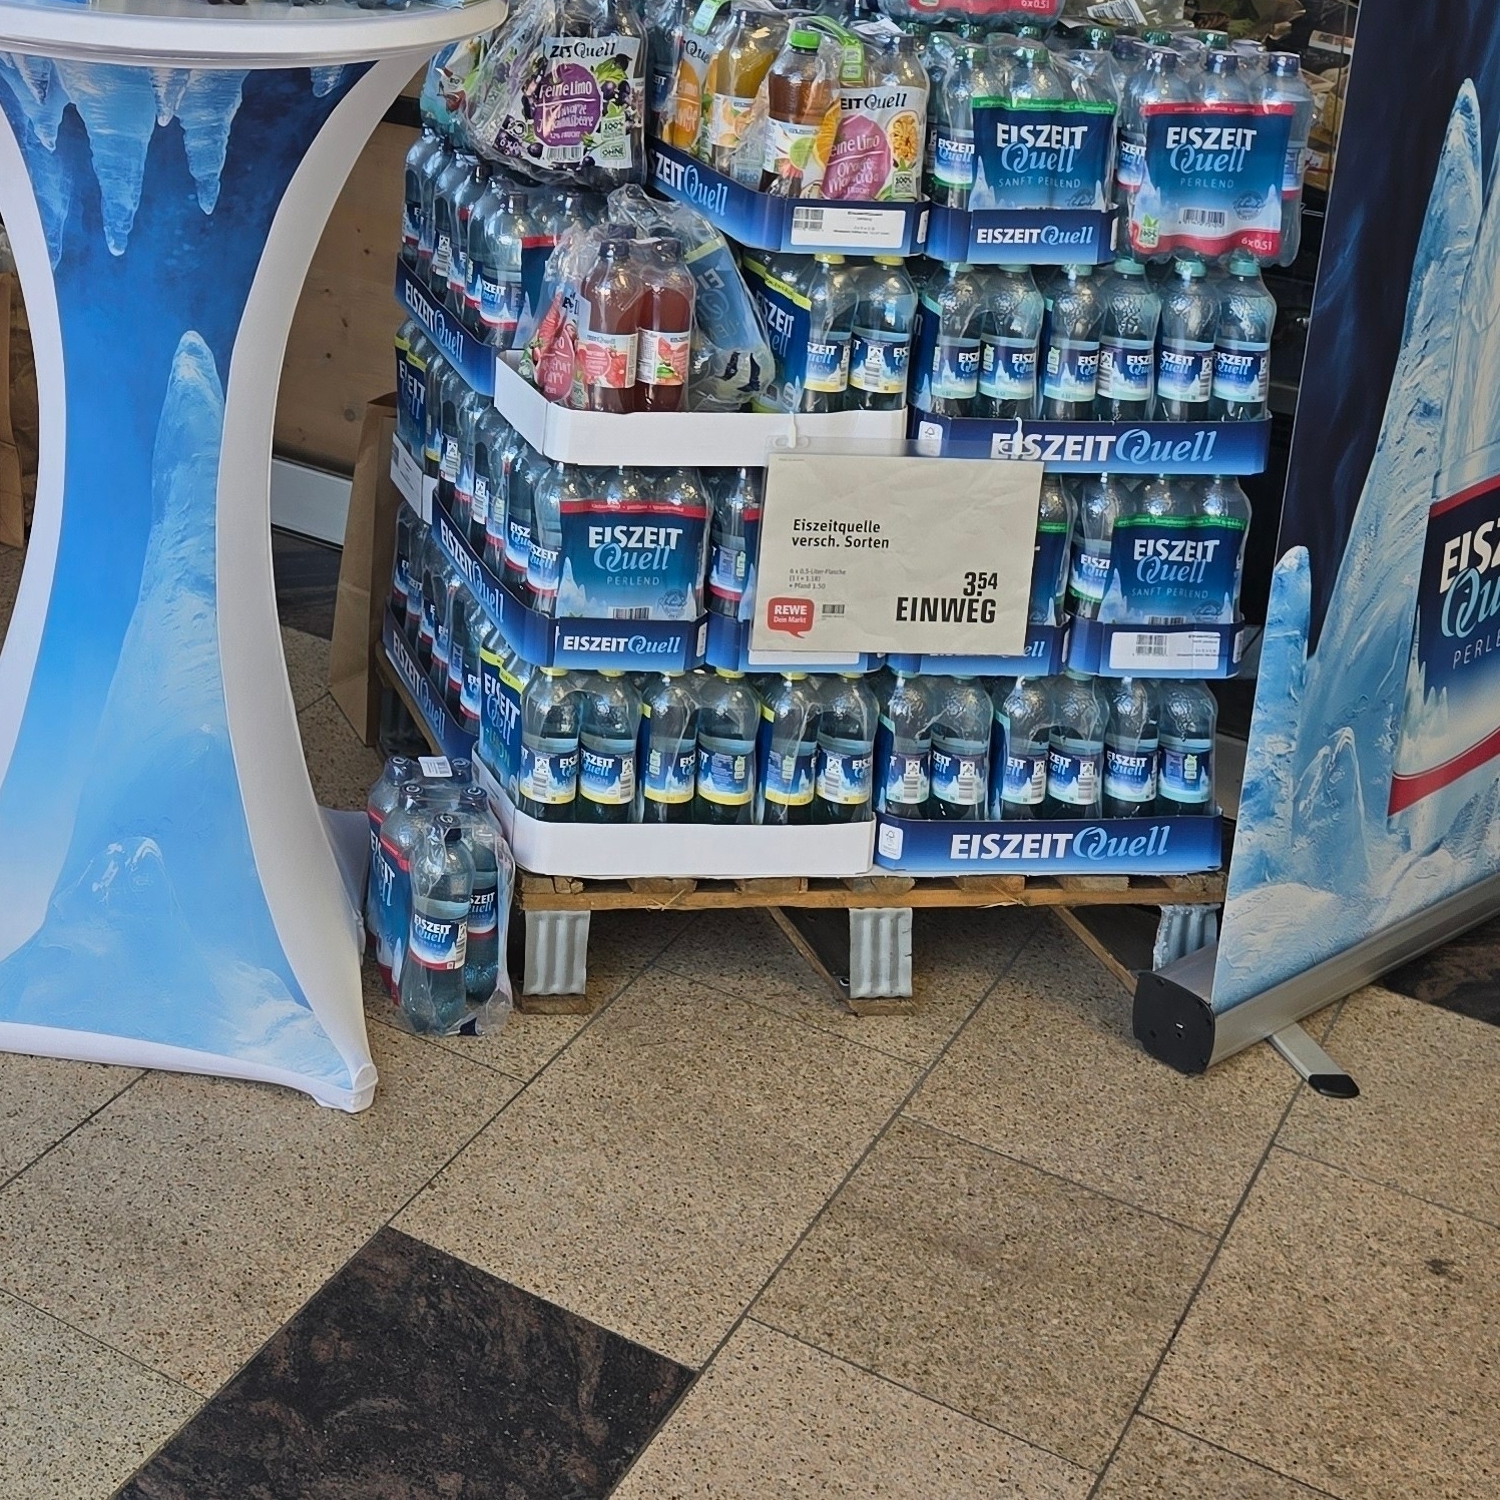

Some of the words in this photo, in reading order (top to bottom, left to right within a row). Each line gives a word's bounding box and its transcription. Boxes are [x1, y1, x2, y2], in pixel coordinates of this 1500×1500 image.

[539, 83, 570, 98] Feine
[570, 80, 593, 95] Limo
[996, 123, 1087, 150] EISZEIT
[1166, 126, 1257, 151] EISZEIT
[1001, 142, 1075, 173] Quell
[1170, 145, 1246, 173] Quell
[1180, 177, 1234, 189] PERLEND
[588, 526, 683, 550] EISZEIT
[793, 518, 881, 535] Eiszeitquelle
[792, 535, 840, 548] versch.
[845, 535, 889, 549] Sorten
[1133, 538, 1220, 562] EISZEIT
[594, 542, 670, 573] Quell
[606, 575, 660, 586] PERLEND
[1136, 556, 1206, 585] Quell
[963, 572, 998, 597] 3.54
[1131, 587, 1164, 598] SANFT
[1168, 588, 1209, 599] PERLEND
[774, 605, 807, 615] REWE
[896, 597, 996, 623] EINWEG
[950, 825, 1172, 860] EISZEITQuell
